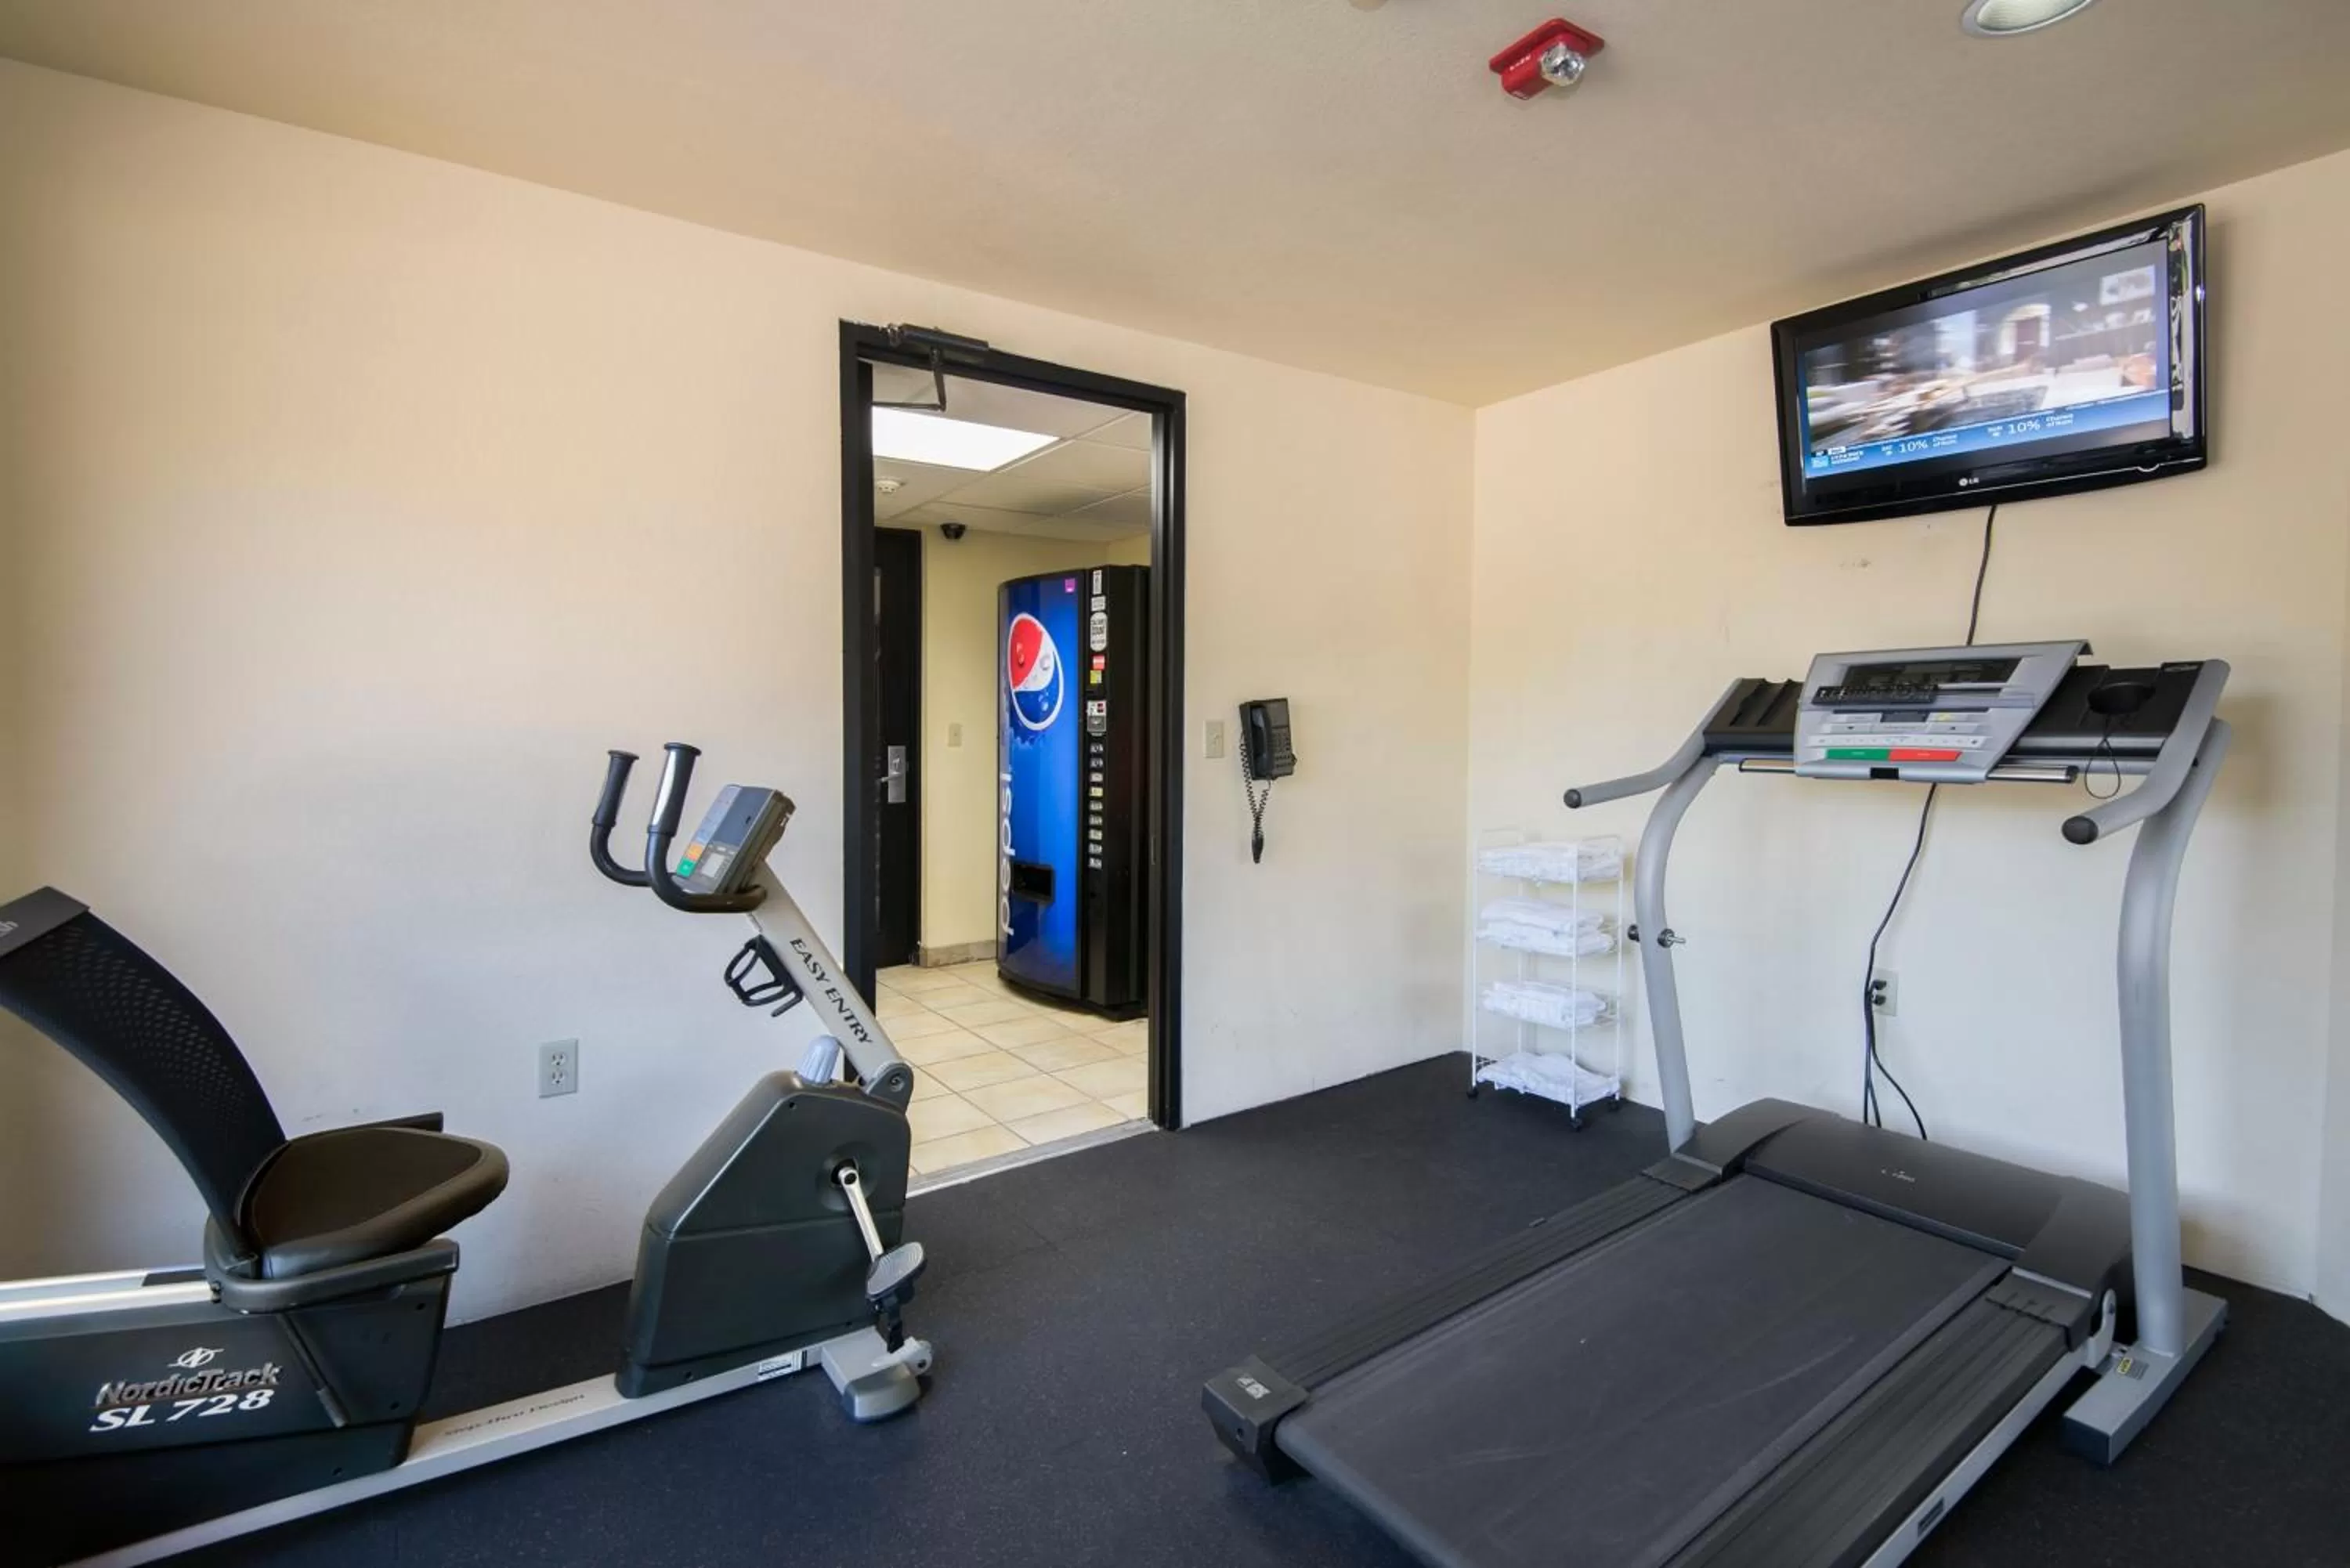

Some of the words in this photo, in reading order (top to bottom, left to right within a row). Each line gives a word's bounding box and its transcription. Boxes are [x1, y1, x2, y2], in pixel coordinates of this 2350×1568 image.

[1899, 439, 1929, 453] 10%
[2008, 420, 2041, 435] 10%
[1000, 771, 1016, 936] pepsi
[790, 938, 830, 985] EASY
[825, 987, 874, 1044] ENTRY
[95, 1361, 284, 1407] NordicTrack
[89, 1404, 156, 1433] SL
[165, 1389, 276, 1422] 728
